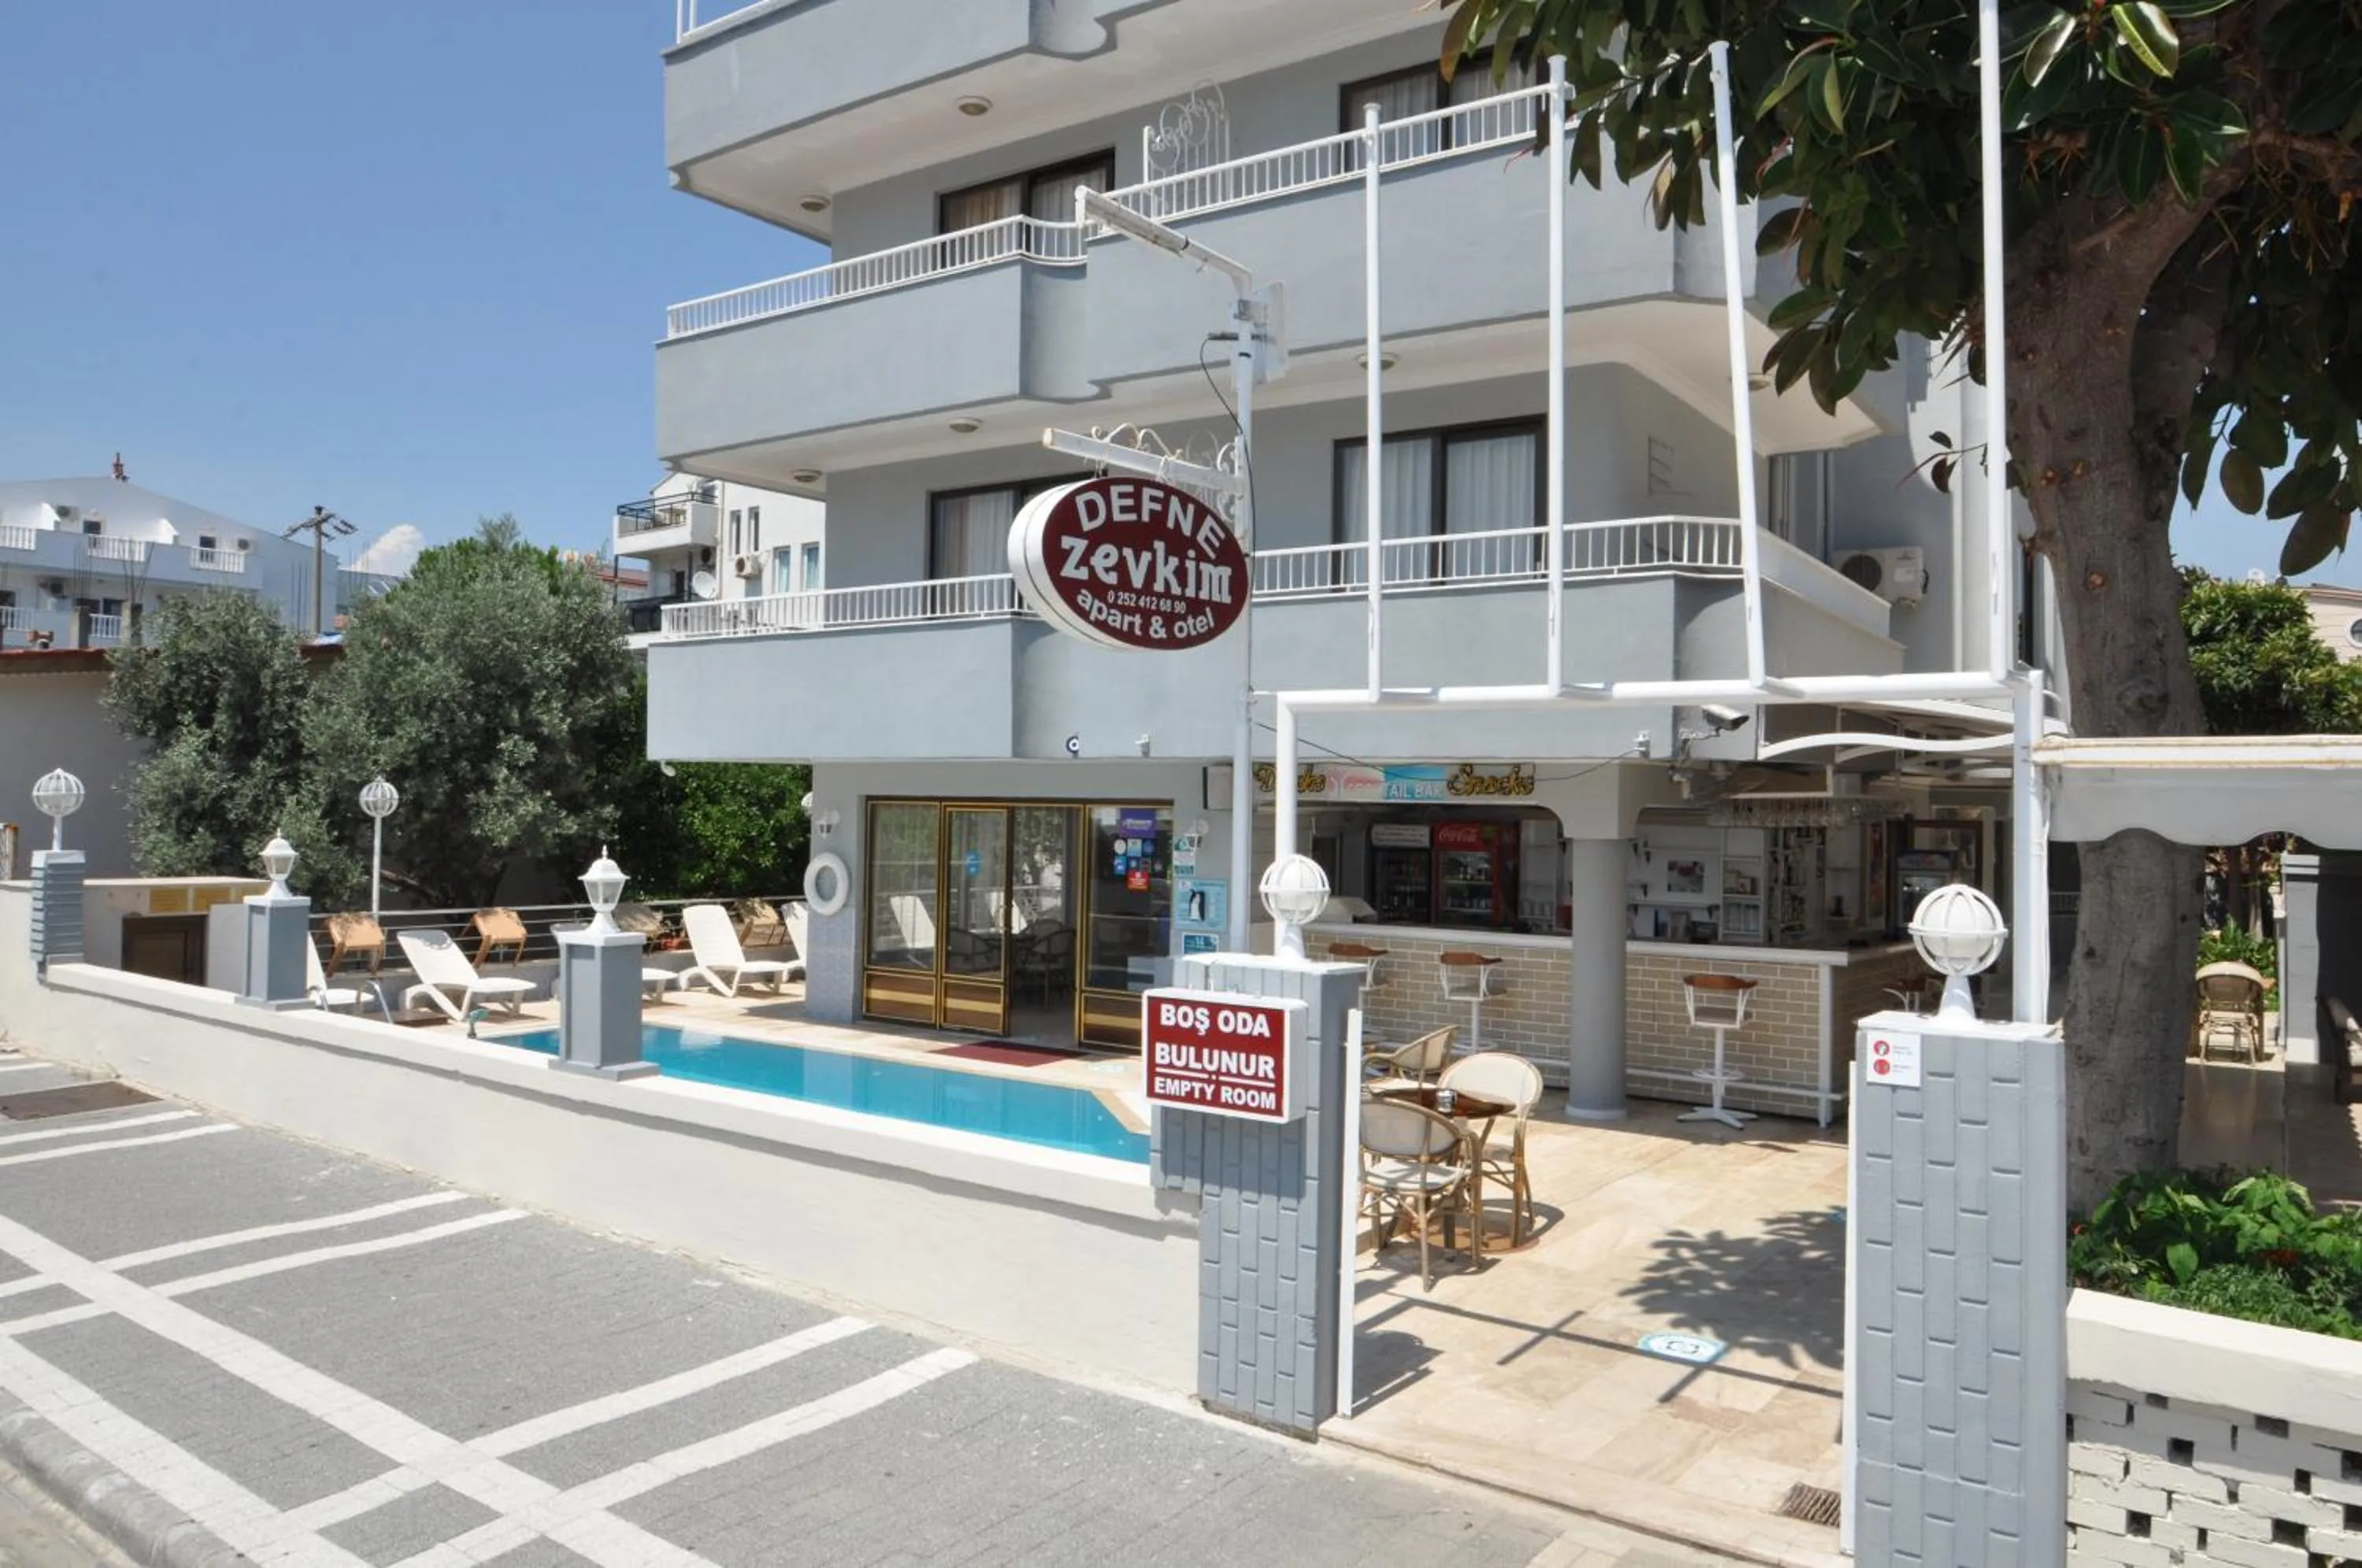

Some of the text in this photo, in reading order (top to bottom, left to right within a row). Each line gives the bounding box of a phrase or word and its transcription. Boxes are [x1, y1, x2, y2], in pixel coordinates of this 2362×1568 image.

[1075, 484, 1225, 558] DEFNE
[1077, 589, 1215, 638] apart & otel
[1108, 590, 1115, 603] 0
[1117, 591, 1136, 607] 252
[1138, 595, 1157, 610] 412
[1160, 1004, 1271, 1037] BOŞ ODA
[1155, 1041, 1275, 1079] BULUNUR
[1154, 1077, 1275, 1110] EMPTY ROOM
